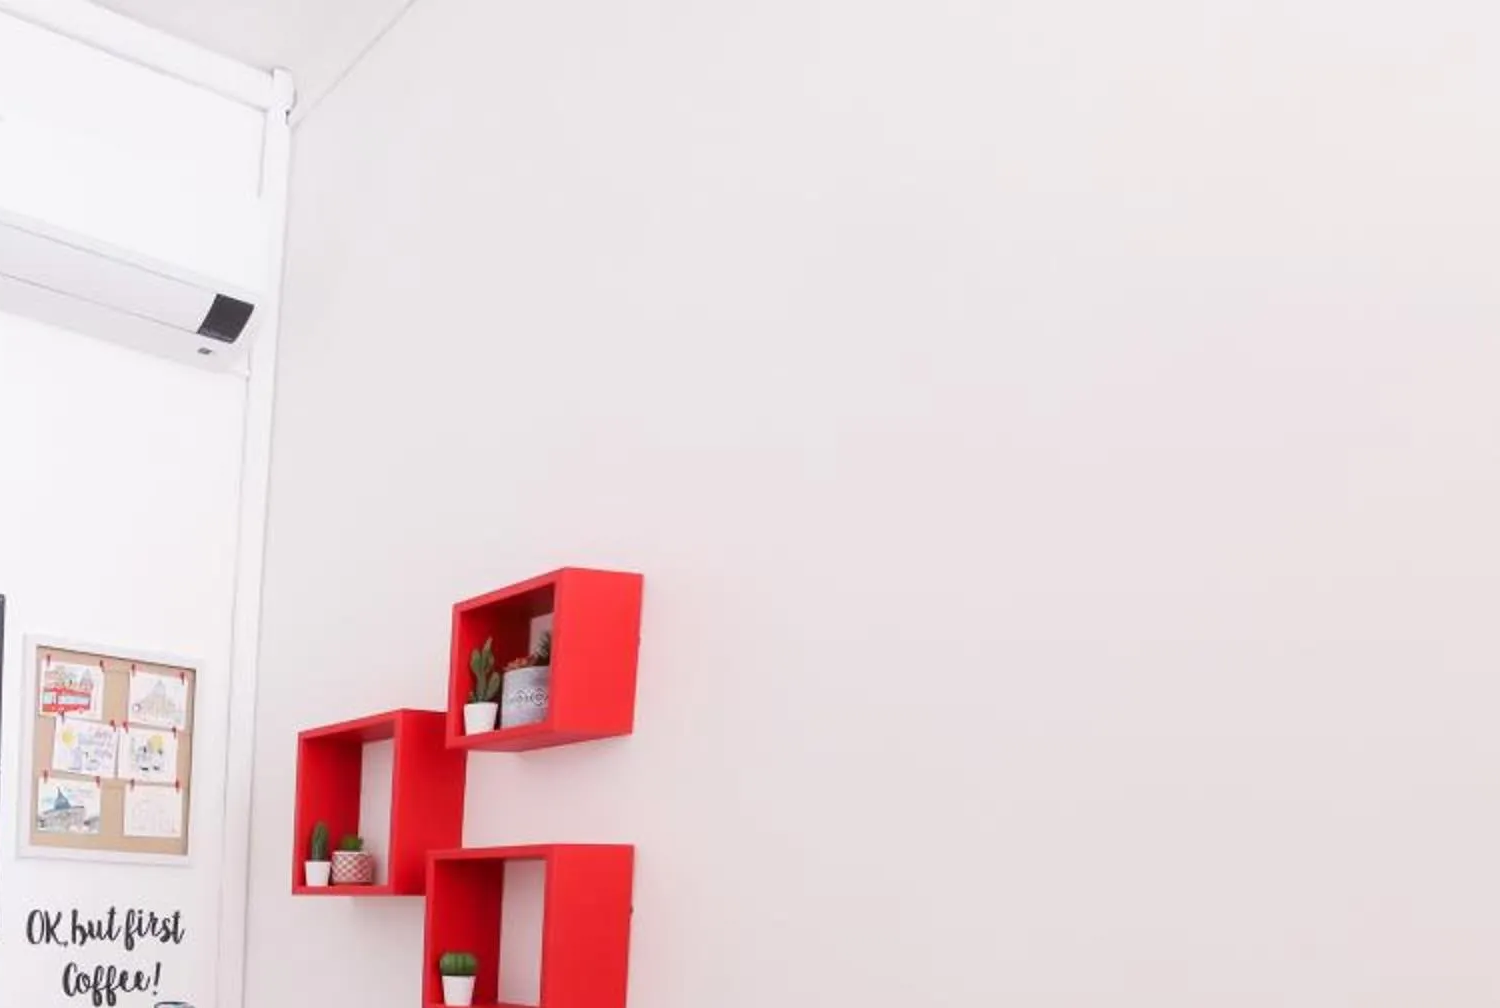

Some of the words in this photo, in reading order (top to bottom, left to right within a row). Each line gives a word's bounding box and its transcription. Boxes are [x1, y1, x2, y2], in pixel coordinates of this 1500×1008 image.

[71, 906, 122, 947] but
[124, 908, 185, 951] first
[62, 961, 162, 1007] Coffee!
